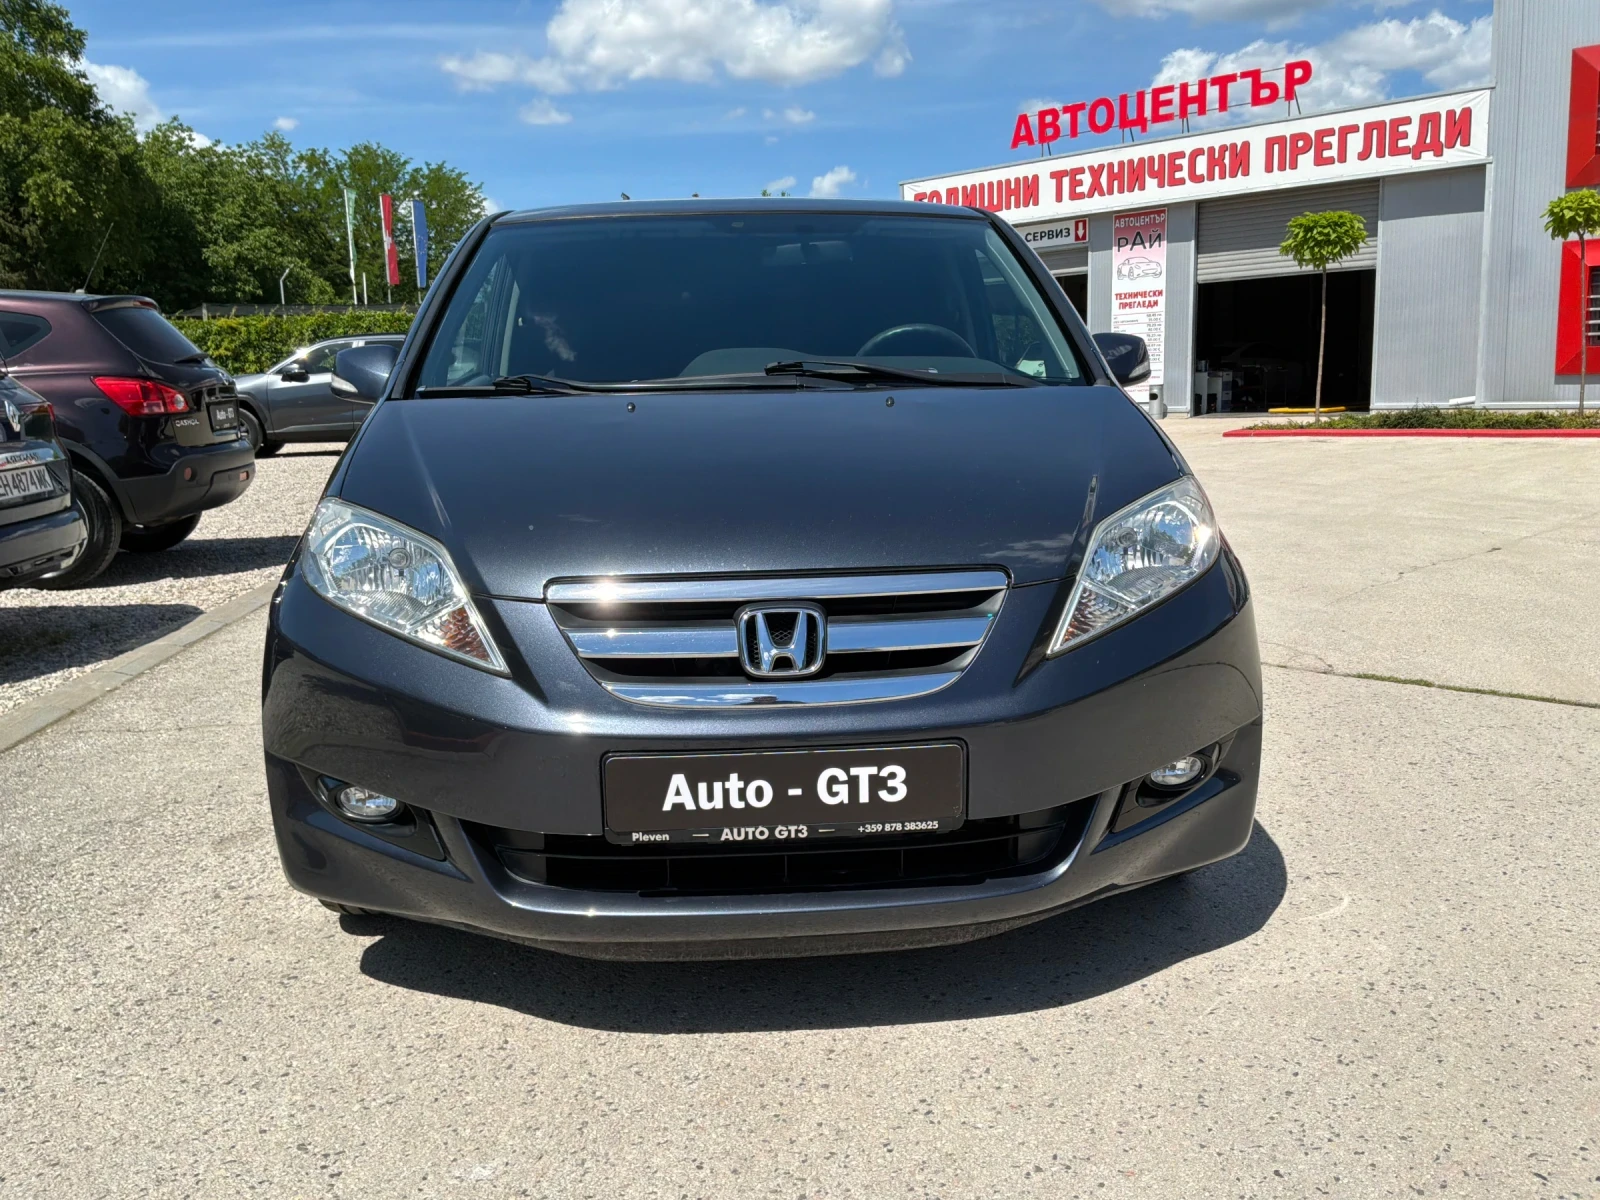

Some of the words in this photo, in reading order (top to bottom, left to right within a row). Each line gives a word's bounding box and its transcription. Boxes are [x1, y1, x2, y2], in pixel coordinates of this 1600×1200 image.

[1010, 60, 1313, 149] АВТОЦЕНТЪР
[1050, 140, 1250, 202] ТЕХНИЧЕСКИ
[1265, 106, 1472, 174] ПРЕГЛЕДИ
[1115, 213, 1166, 229] АВТОЦЕНТЪР
[1025, 227, 1070, 242] СЕРВИЗ
[1115, 289, 1163, 301] ТЕХНИЧЕСКИ
[1119, 299, 1158, 310] ПРЕГЛЕДИ
[662, 773, 773, 811] Auto
[817, 765, 907, 805] GT3
[632, 832, 670, 842] Pleven
[720, 826, 769, 842] AUTO
[774, 825, 808, 839] GT3
[857, 825, 882, 834] +359
[884, 823, 902, 833] 878
[904, 820, 938, 831] 383625
